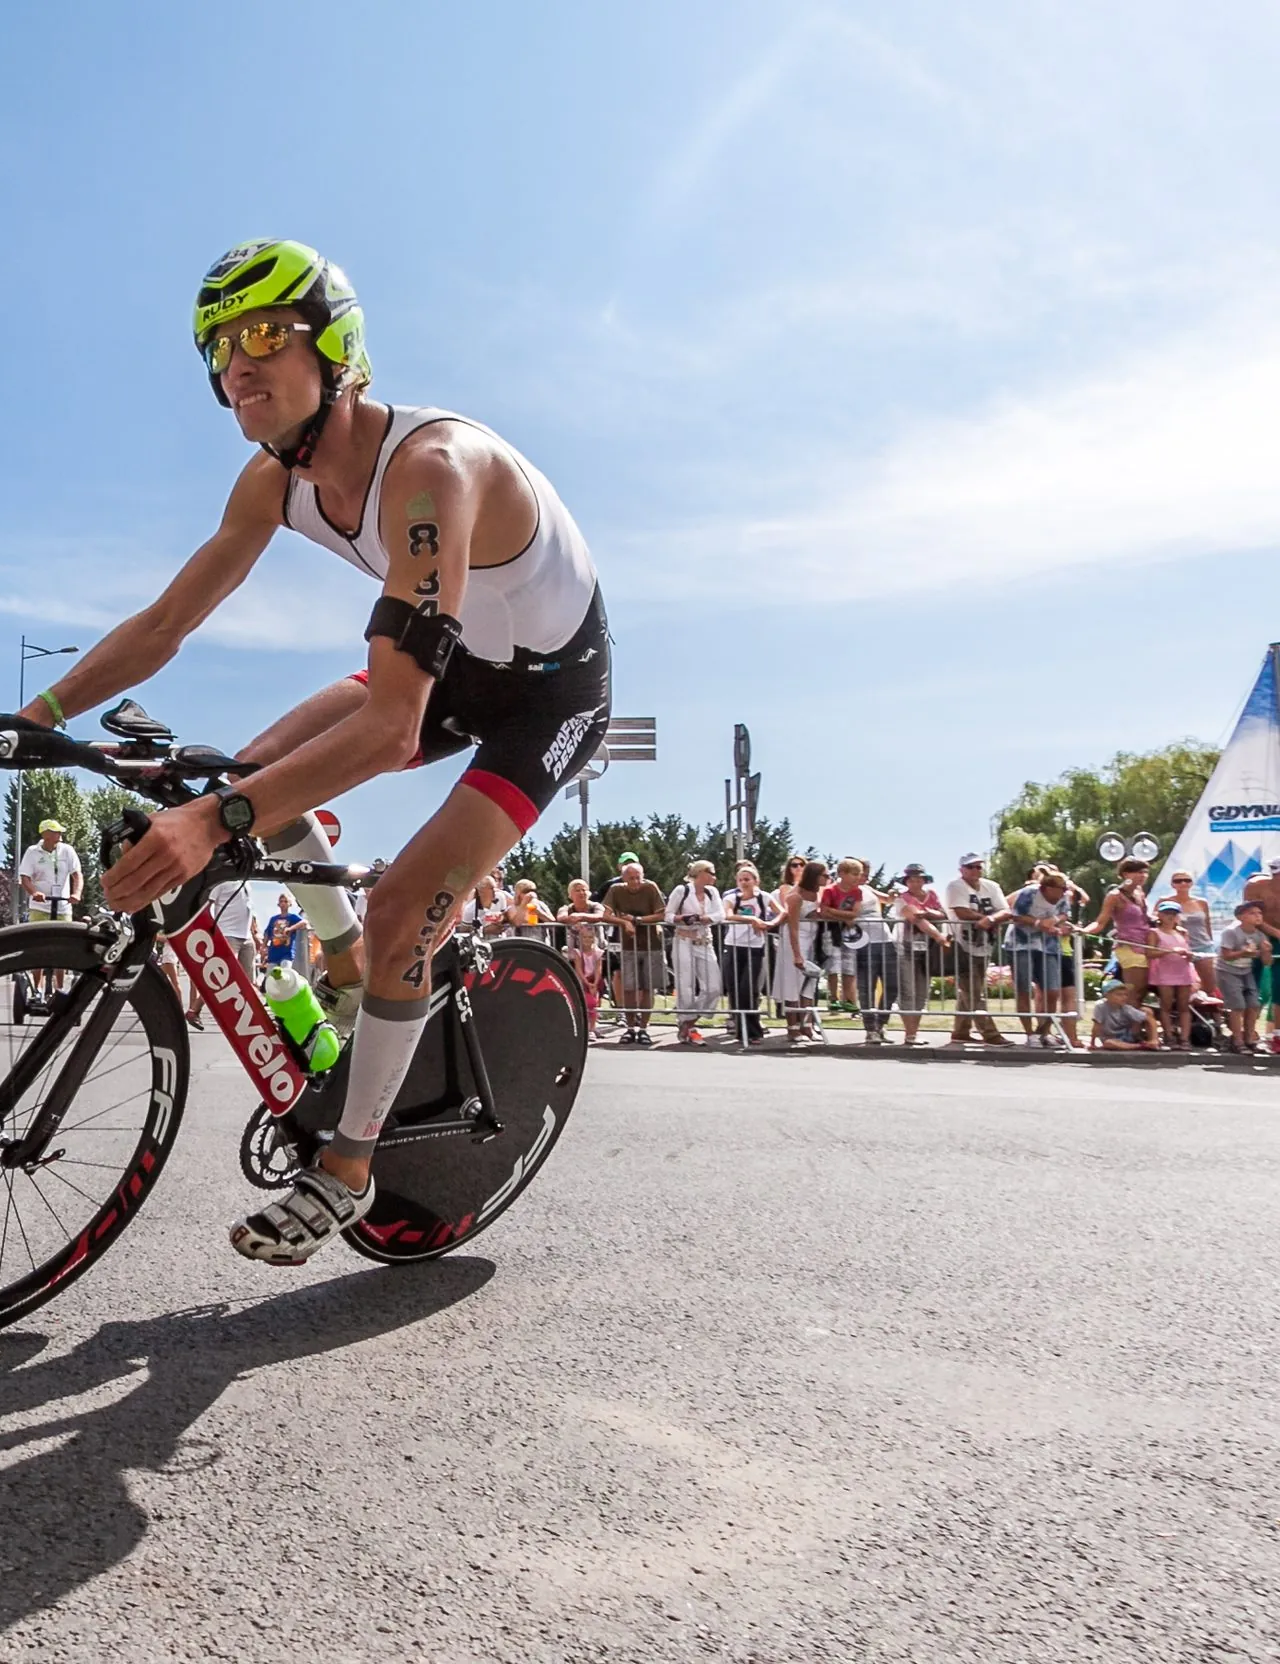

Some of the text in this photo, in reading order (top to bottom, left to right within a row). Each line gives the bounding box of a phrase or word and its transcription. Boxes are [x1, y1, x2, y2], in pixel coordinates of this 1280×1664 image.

[203, 292, 249, 322] RUDY
[1208, 804, 1280, 821] GDYNI
[186, 928, 294, 1102] cervélo
[415, 1132, 439, 1141] WHITE
[441, 1127, 471, 1137] DESIGN
